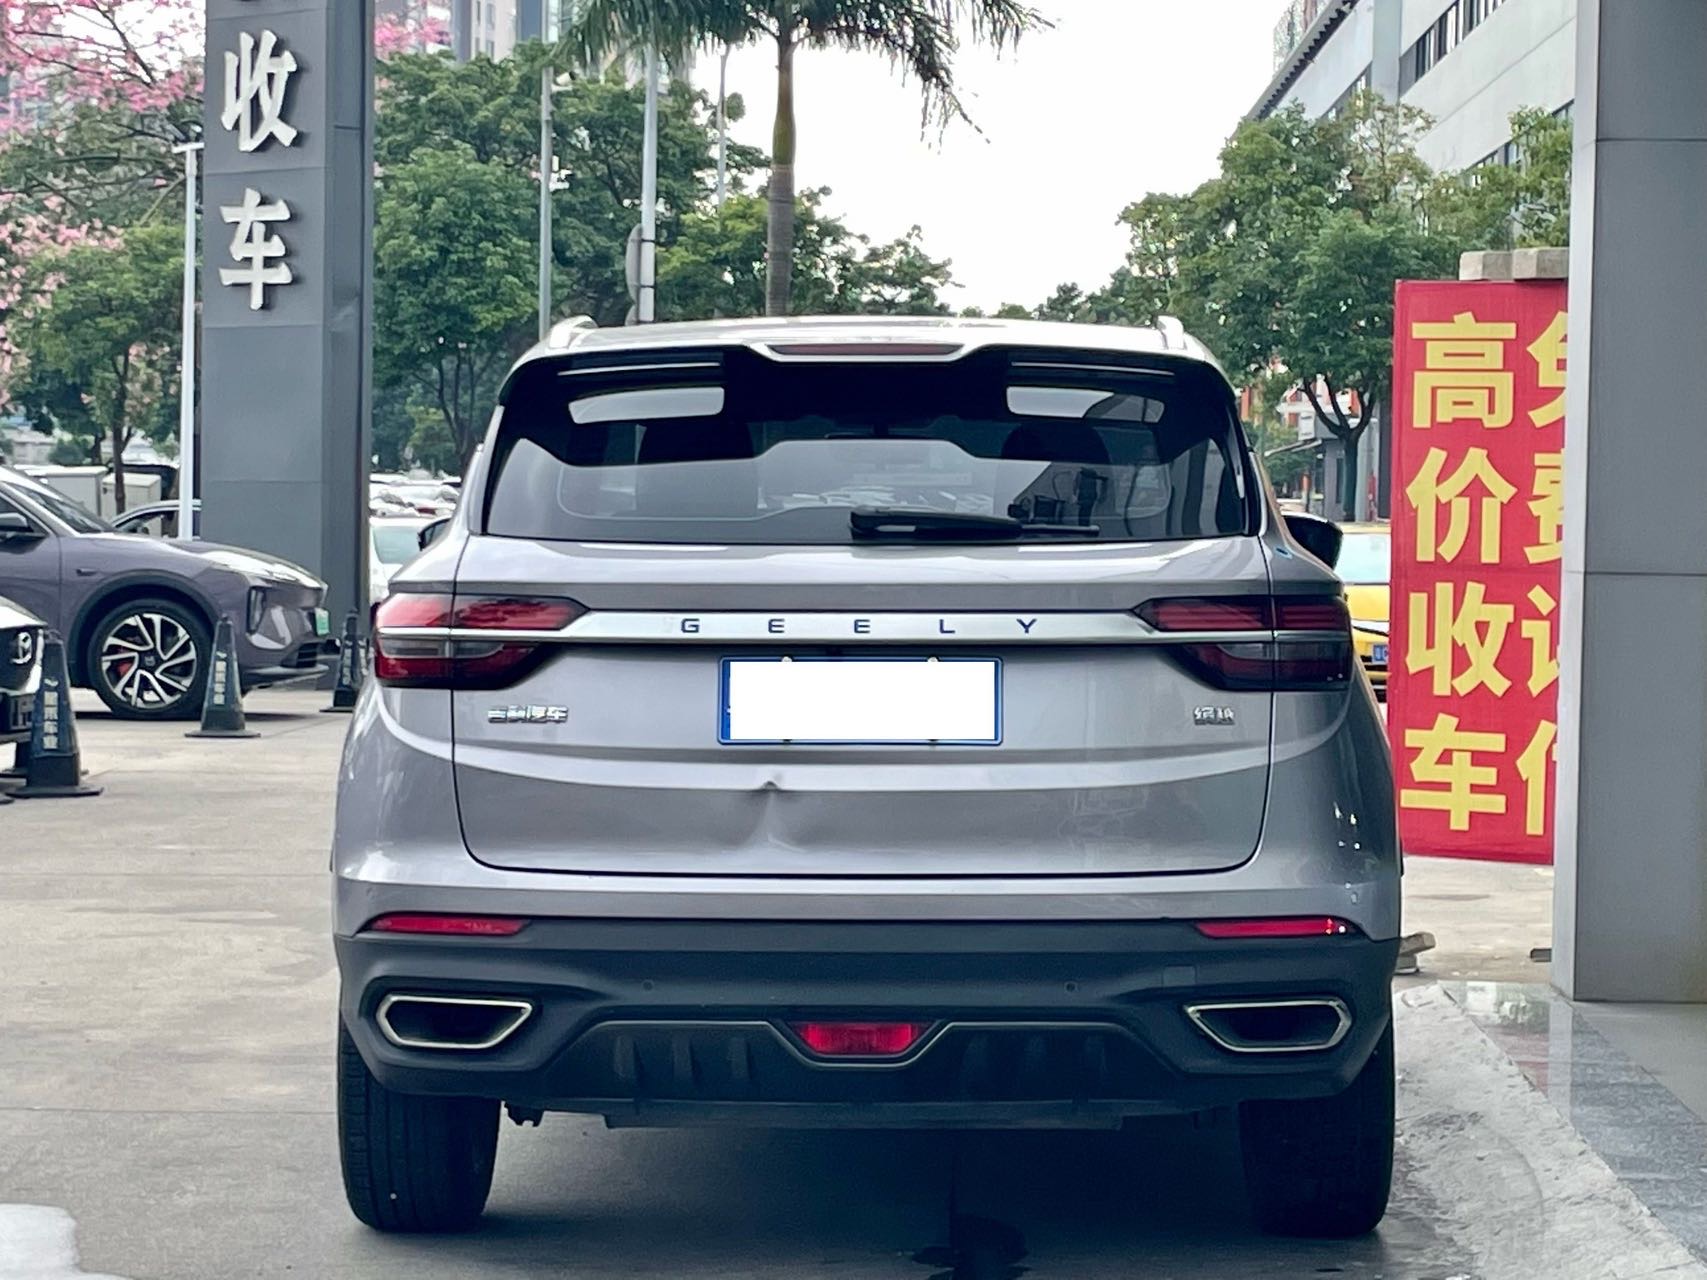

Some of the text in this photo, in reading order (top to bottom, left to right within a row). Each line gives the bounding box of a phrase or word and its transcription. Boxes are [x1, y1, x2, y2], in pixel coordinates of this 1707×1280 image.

[219, 29, 299, 311] 收车
[680, 618, 1038, 634] GEELY
[1400, 312, 1518, 831] 高价收车
